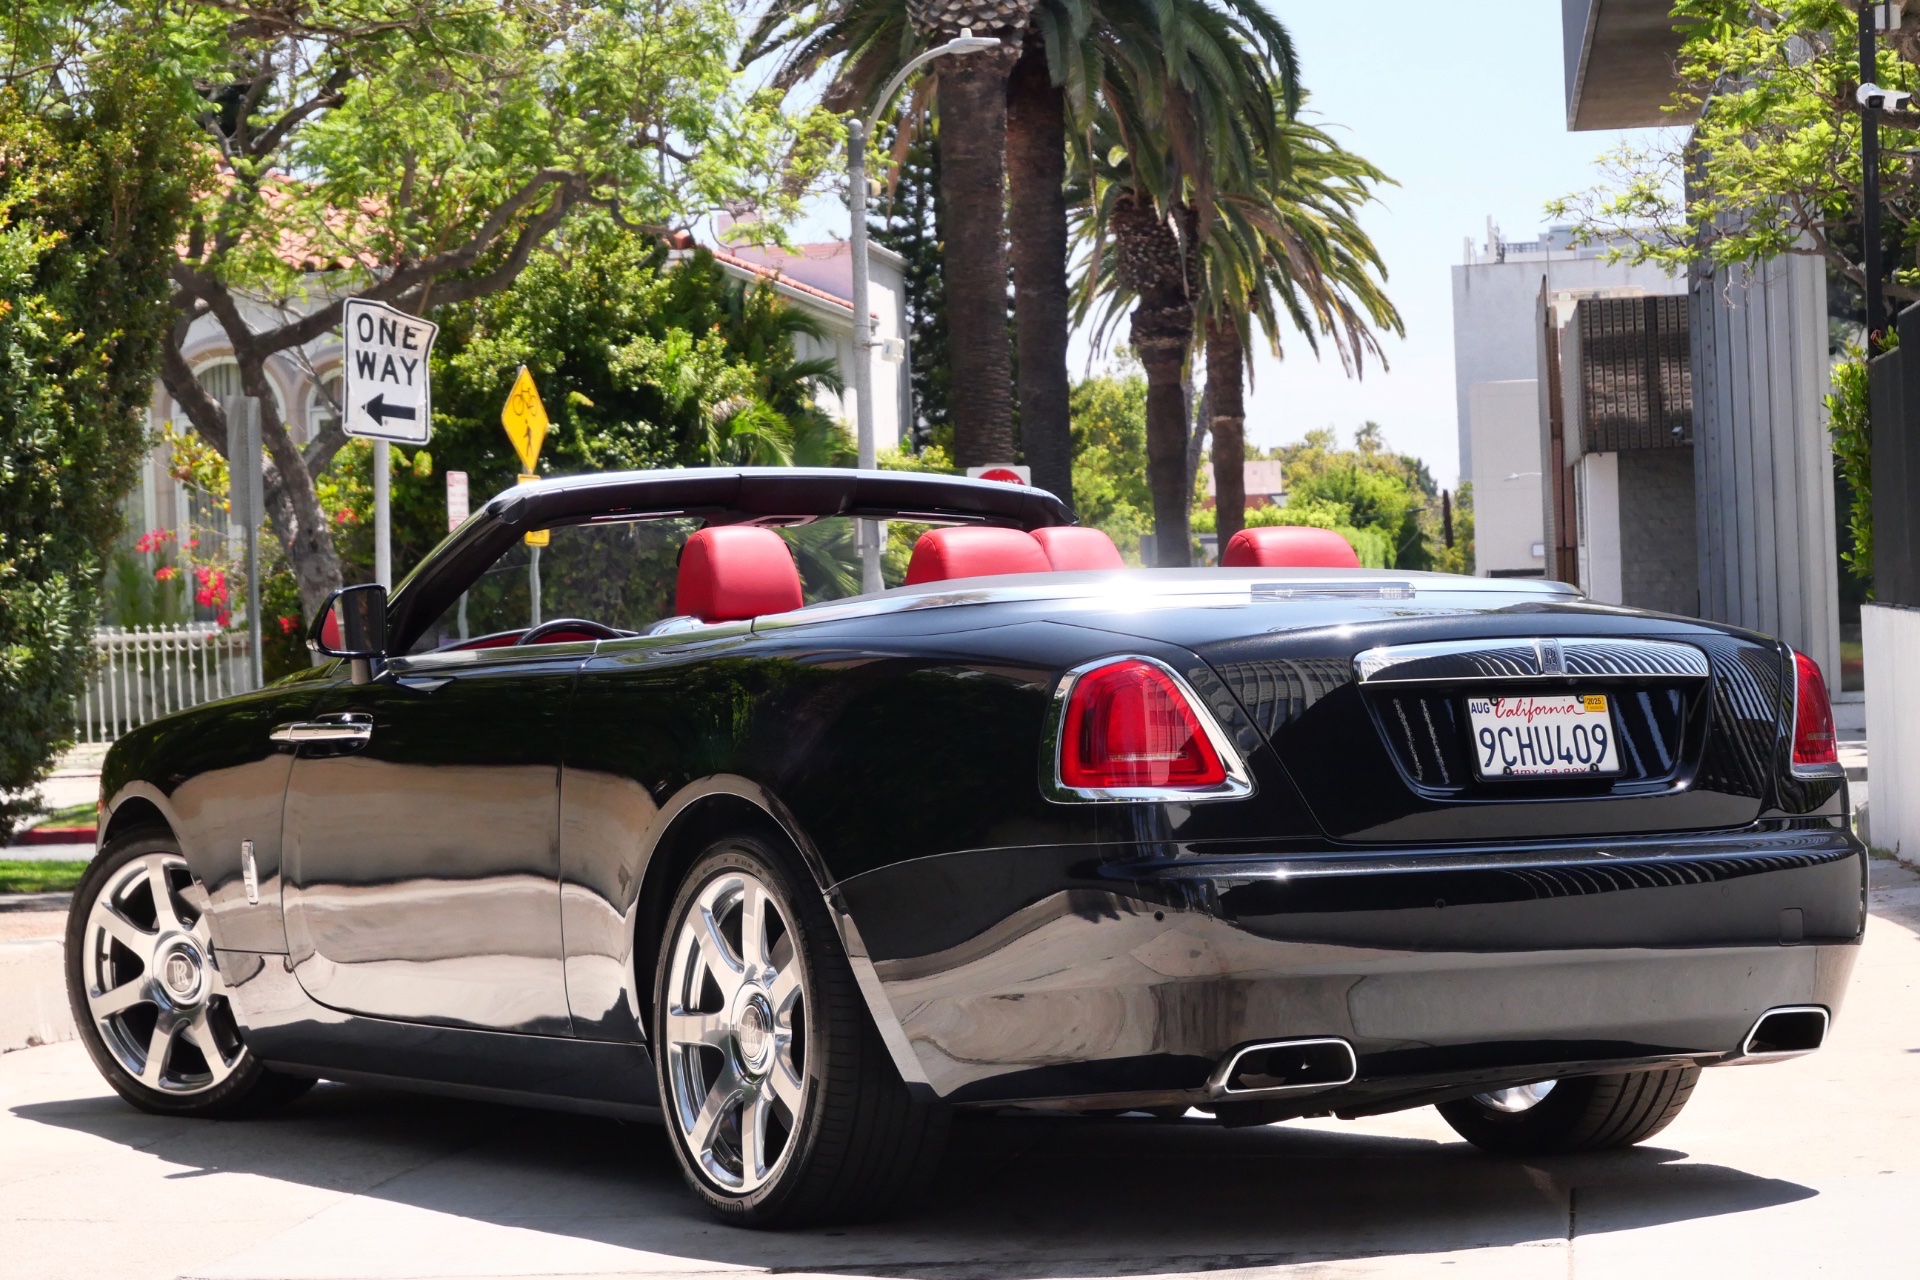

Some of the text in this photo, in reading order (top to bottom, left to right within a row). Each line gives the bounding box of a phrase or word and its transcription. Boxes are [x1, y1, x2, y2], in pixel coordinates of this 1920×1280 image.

[356, 312, 419, 350] ONE
[355, 350, 418, 386] WAY
[1471, 702, 1490, 714] AUG
[1495, 697, 1586, 723] California
[1586, 697, 1602, 705] 2025
[1479, 724, 1608, 768] 9CHU409
